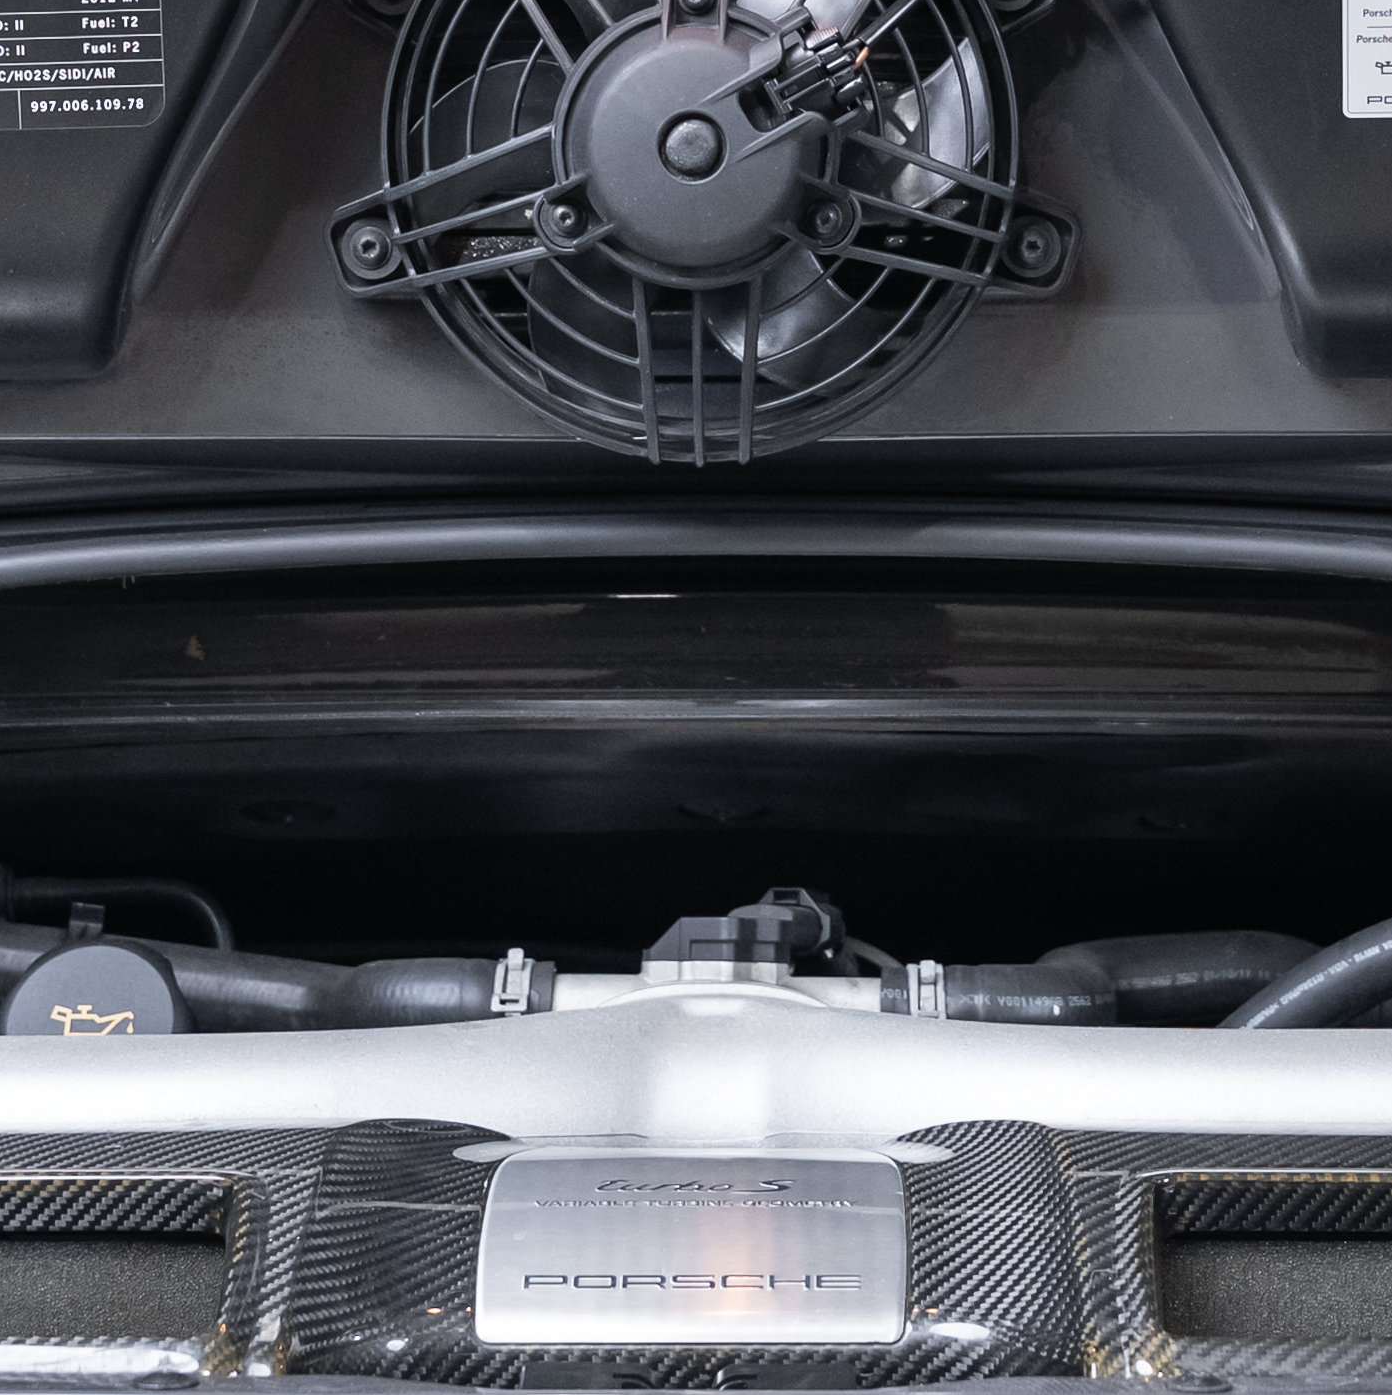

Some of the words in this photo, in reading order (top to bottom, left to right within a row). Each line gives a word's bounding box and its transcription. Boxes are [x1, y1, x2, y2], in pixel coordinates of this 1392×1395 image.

[14, 20, 24, 31] II
[81, 17, 116, 30] Fuel:
[121, 16, 139, 28] T2
[1356, 34, 1392, 43] Porsche
[15, 44, 26, 56] II
[83, 42, 118, 55] Fuel:
[123, 41, 140, 53] P2
[30, 98, 144, 113] 997.006.109.78
[595, 1179, 734, 1193] turbo
[735, 1179, 797, 1193] S
[534, 1199, 636, 1207] VARIABLE
[644, 1199, 734, 1207] TURBINE
[743, 1199, 857, 1207] GEOMETRY
[523, 1274, 862, 1290] PORSCHE
